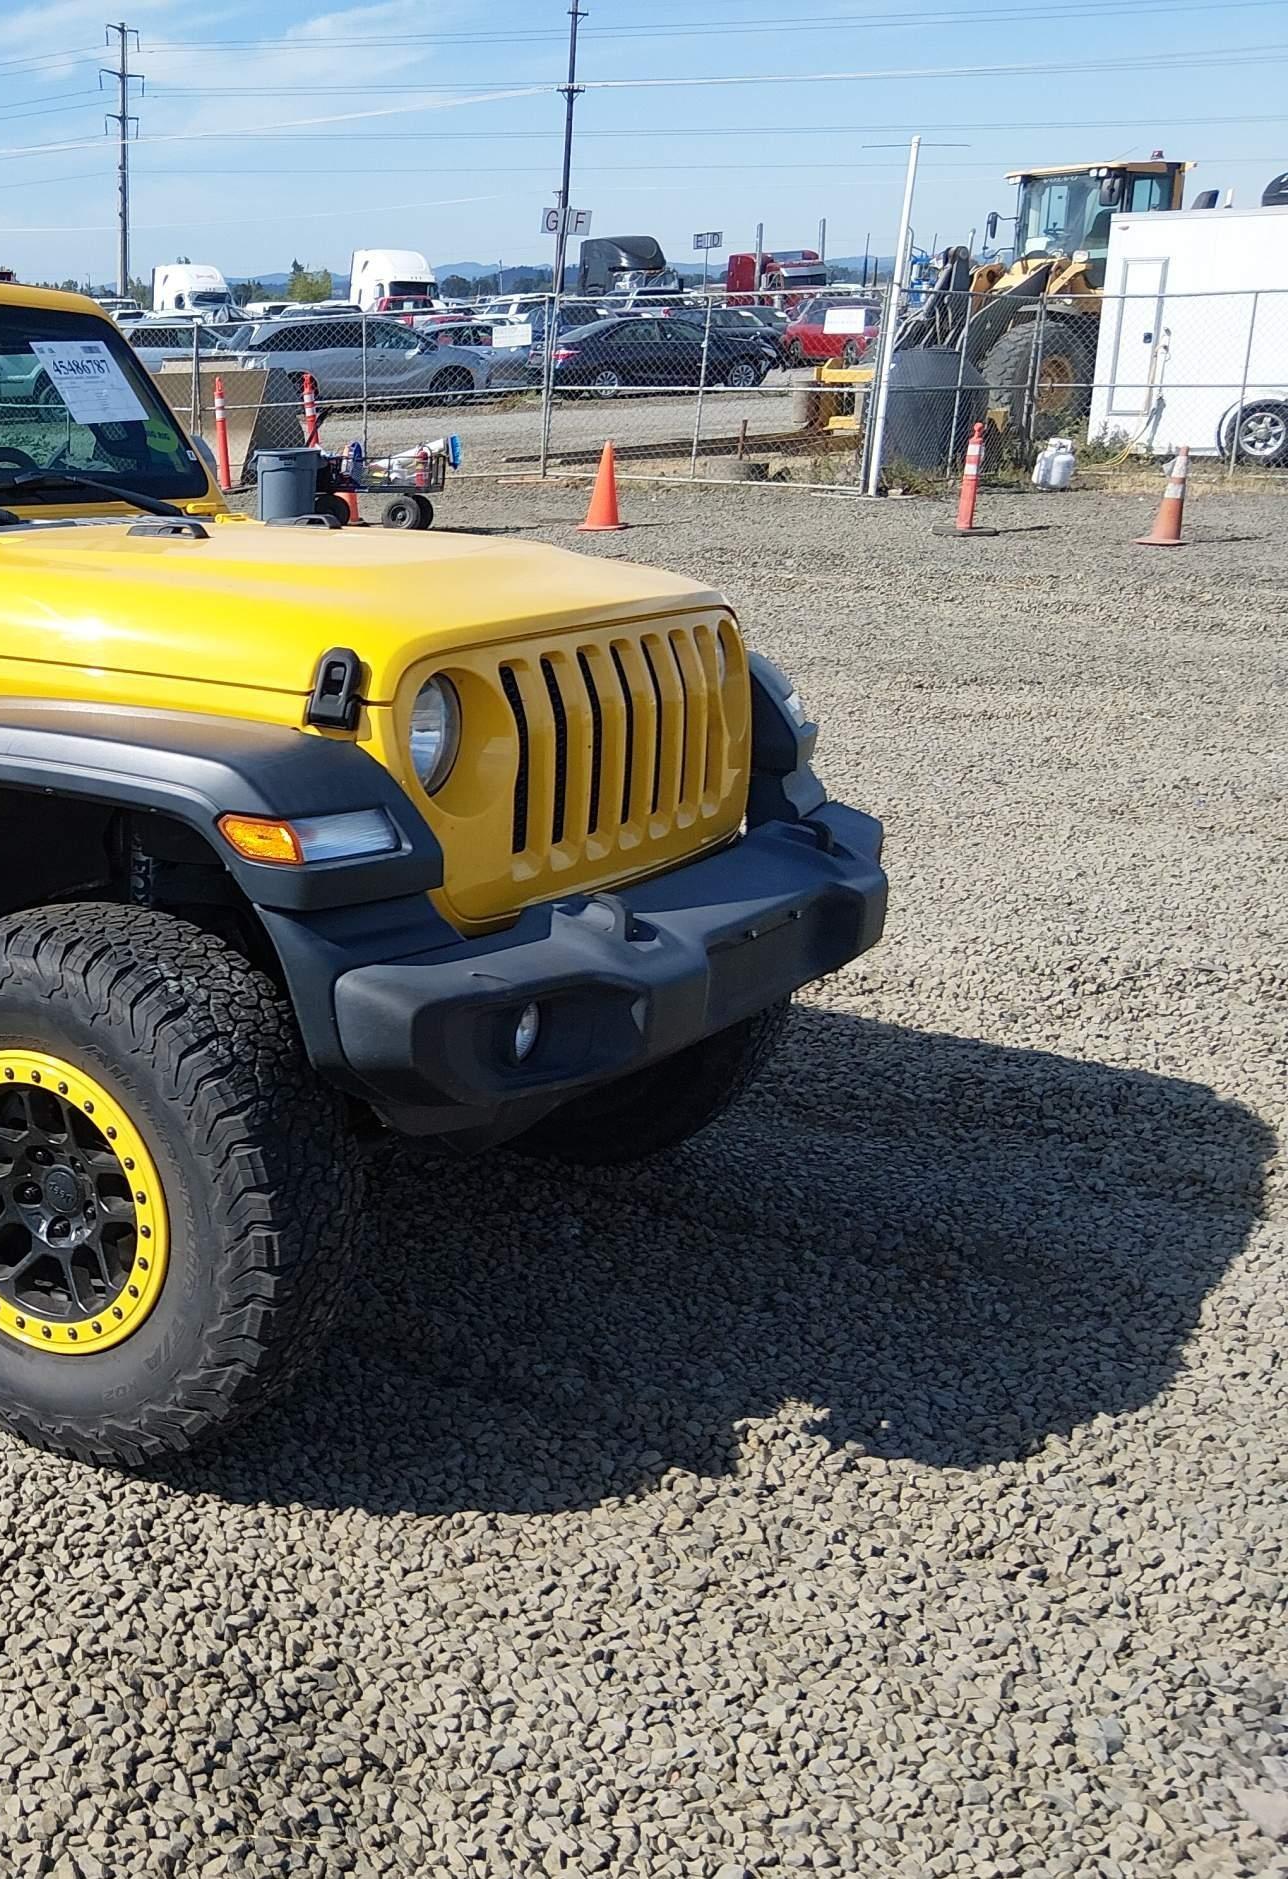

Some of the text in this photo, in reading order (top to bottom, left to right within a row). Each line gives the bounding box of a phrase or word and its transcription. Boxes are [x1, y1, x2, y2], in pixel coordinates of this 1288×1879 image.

[546, 210, 559, 232] G
[574, 212, 587, 233] F
[696, 234, 703, 248] E
[712, 233, 720, 247] D
[52, 359, 110, 376] 45486787
